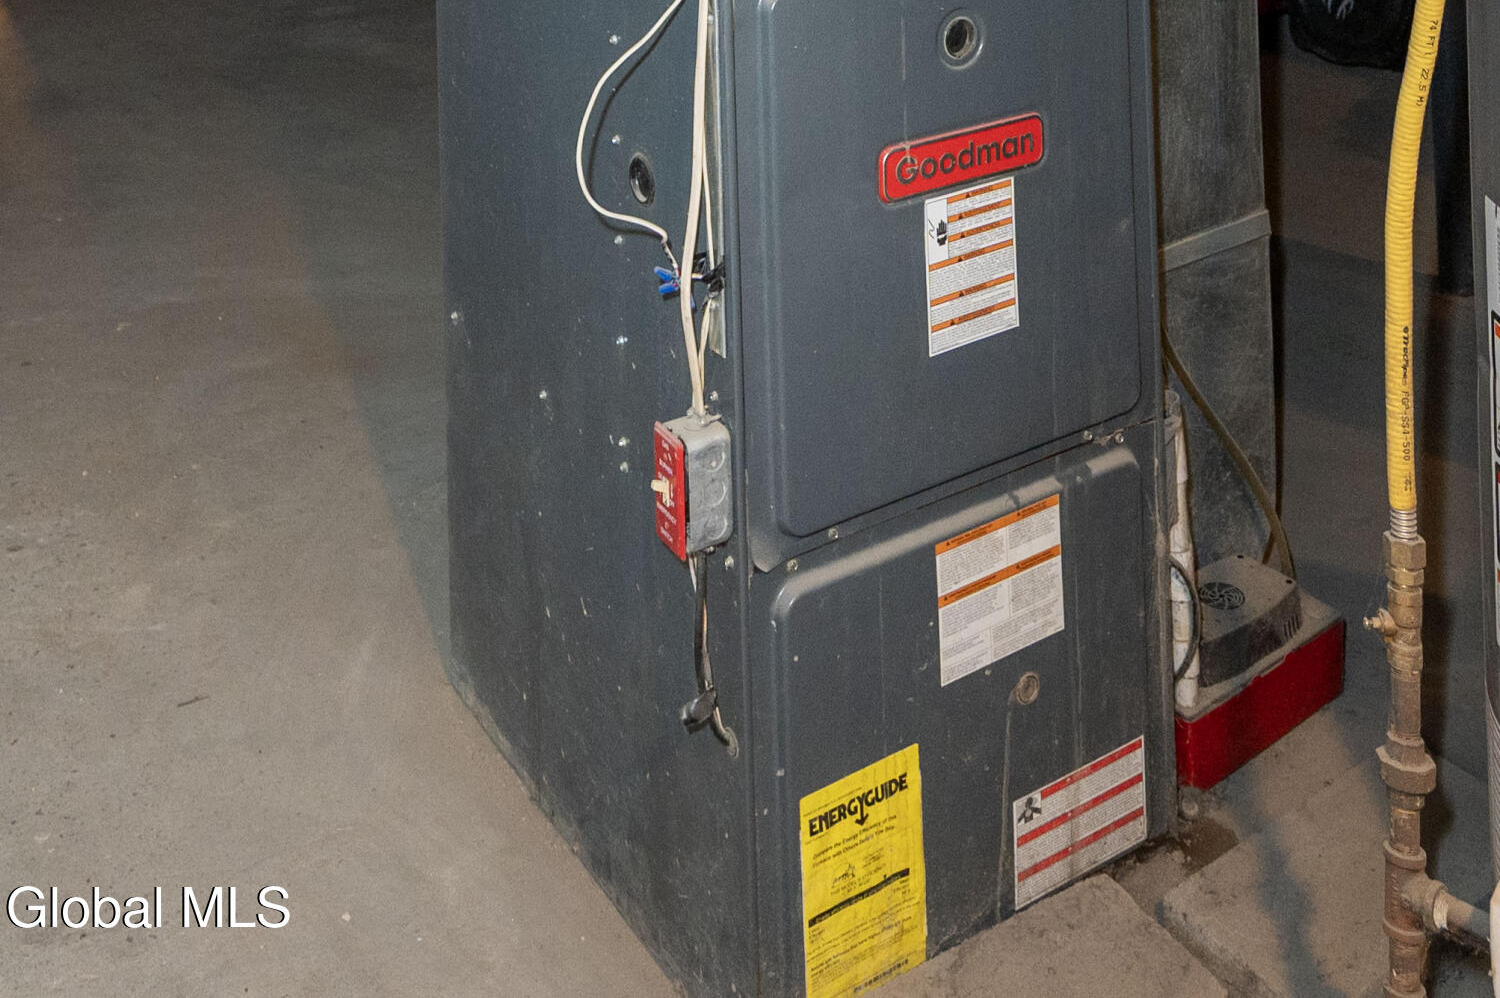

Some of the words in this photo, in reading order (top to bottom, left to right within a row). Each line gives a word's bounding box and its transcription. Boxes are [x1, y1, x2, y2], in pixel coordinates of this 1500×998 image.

[1429, 19, 1439, 31] 74
[1425, 35, 1436, 47] FT
[1418, 68, 1430, 92] 22.5
[896, 131, 1035, 185] Goodman
[808, 771, 908, 837] ENERGYGUIDE
